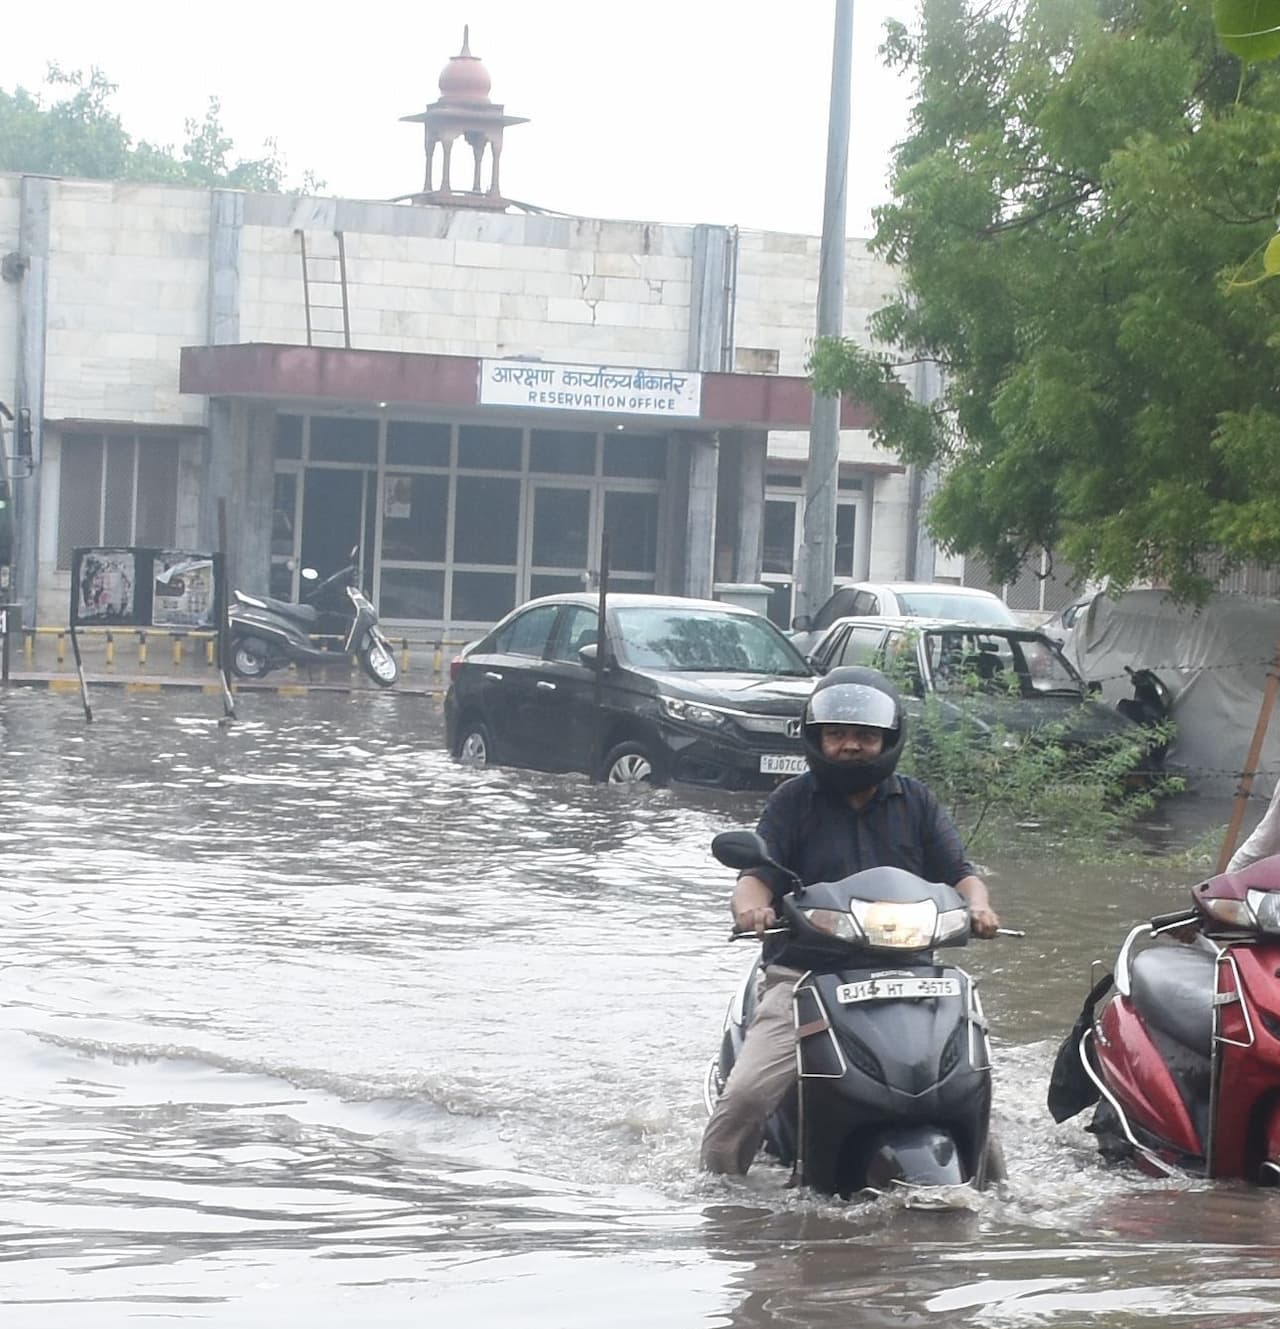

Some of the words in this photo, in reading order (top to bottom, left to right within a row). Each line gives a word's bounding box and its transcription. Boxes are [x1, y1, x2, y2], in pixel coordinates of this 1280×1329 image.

[491, 366, 555, 388] आरक्षण
[561, 366, 632, 391] कार्यालय
[528, 391, 626, 408] RESERVATION
[628, 397, 675, 410] OFFICE
[886, 983, 904, 996] HT
